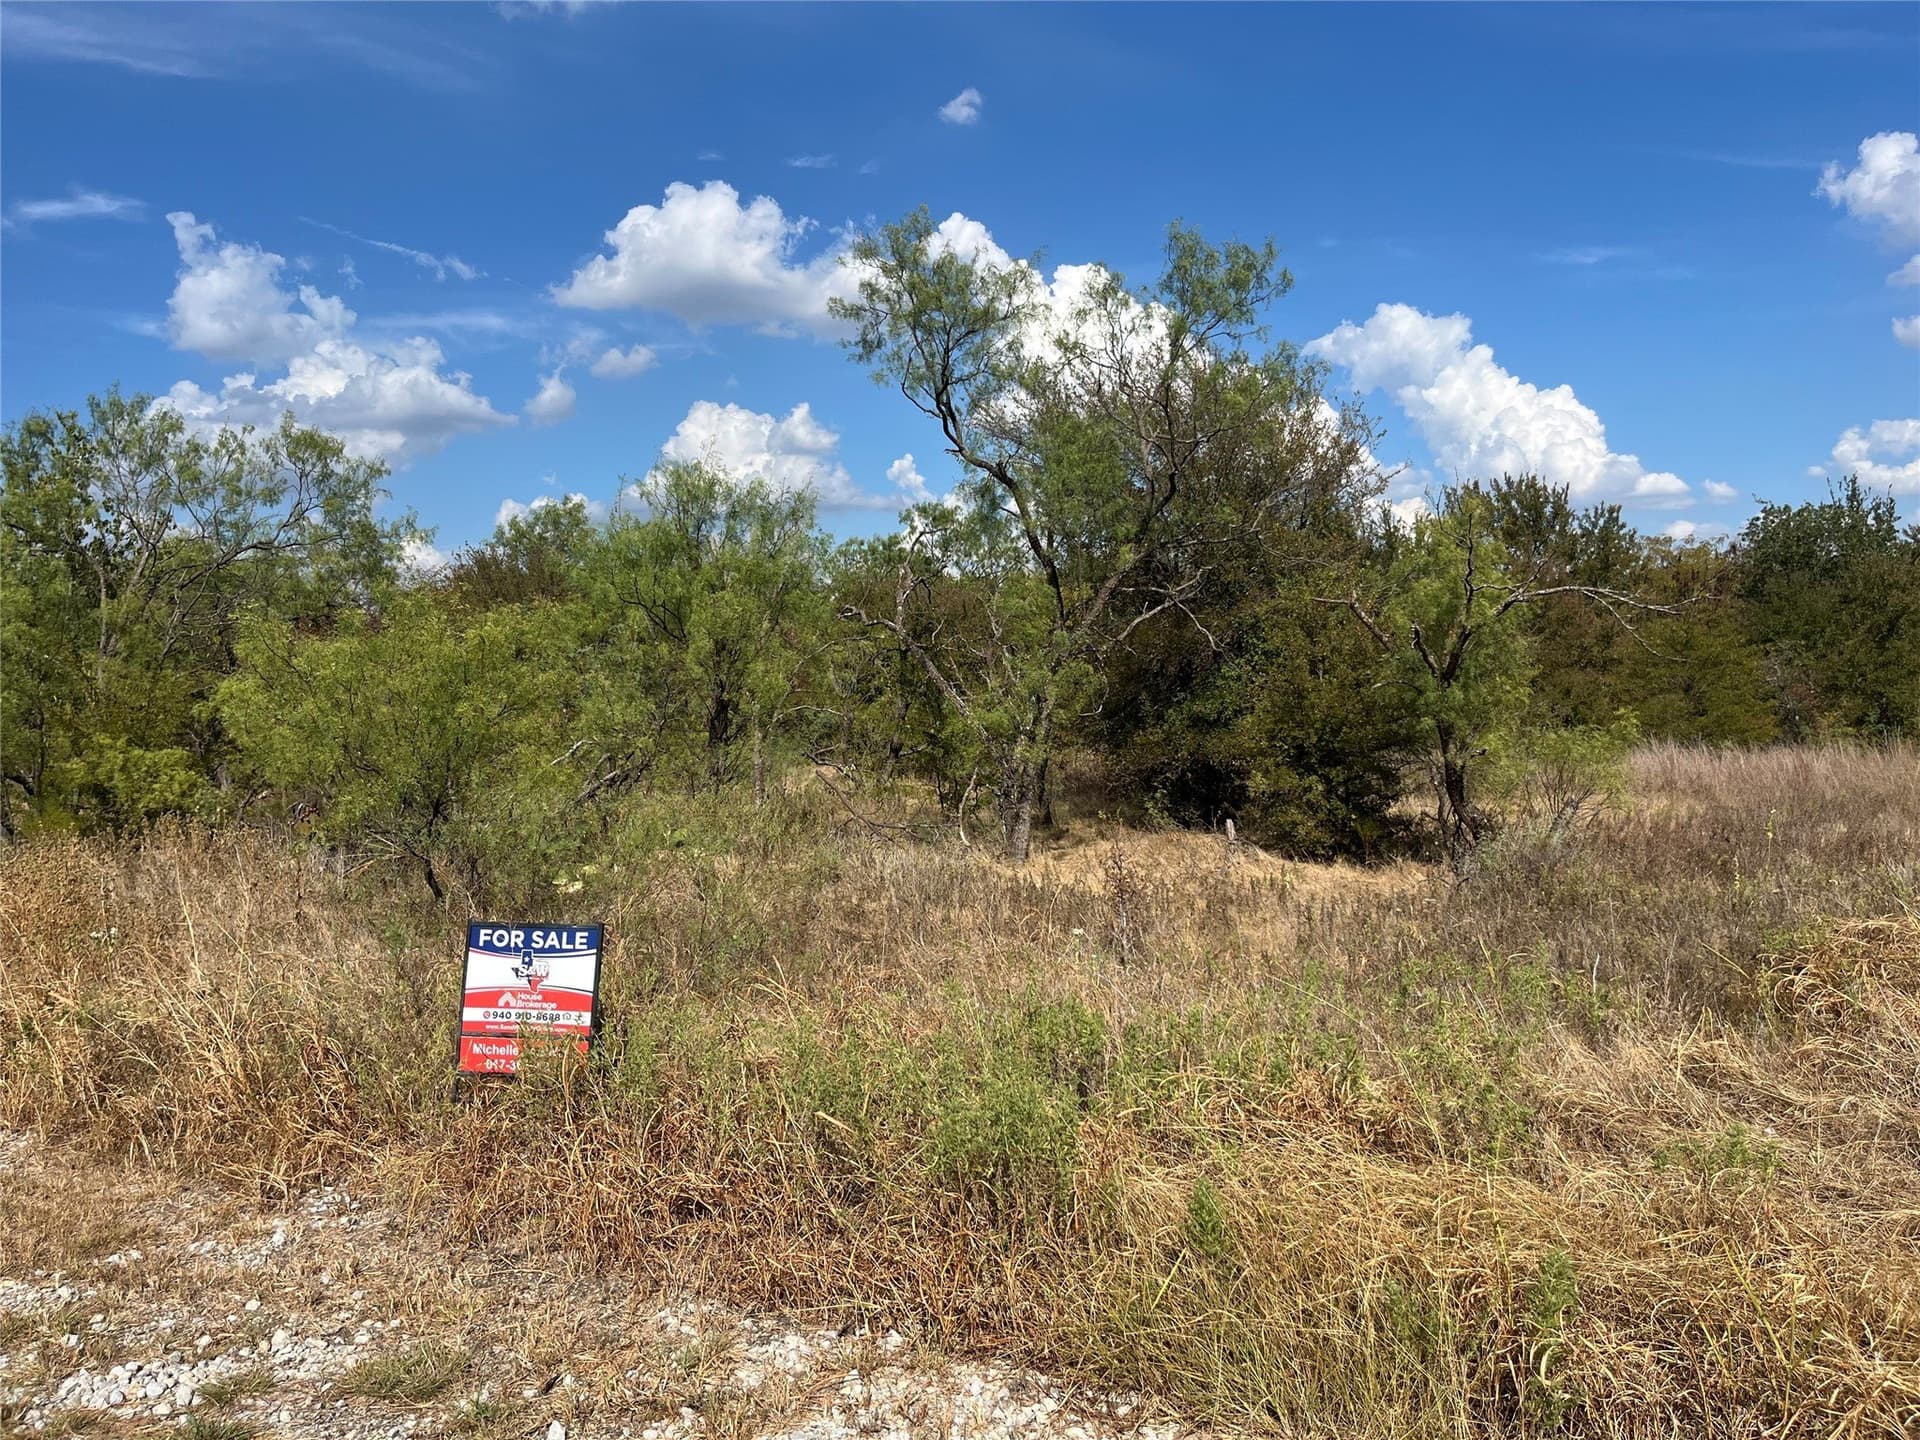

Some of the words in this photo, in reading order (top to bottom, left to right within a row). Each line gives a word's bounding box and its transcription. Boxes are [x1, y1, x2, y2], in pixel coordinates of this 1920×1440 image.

[478, 929, 525, 947] FOR
[531, 931, 589, 950] SALE
[518, 964, 550, 978] S&W
[517, 991, 543, 1001] House
[517, 1000, 558, 1010] Brokerage
[492, 1010, 512, 1020] 940
[472, 1042, 519, 1056] Michelle
